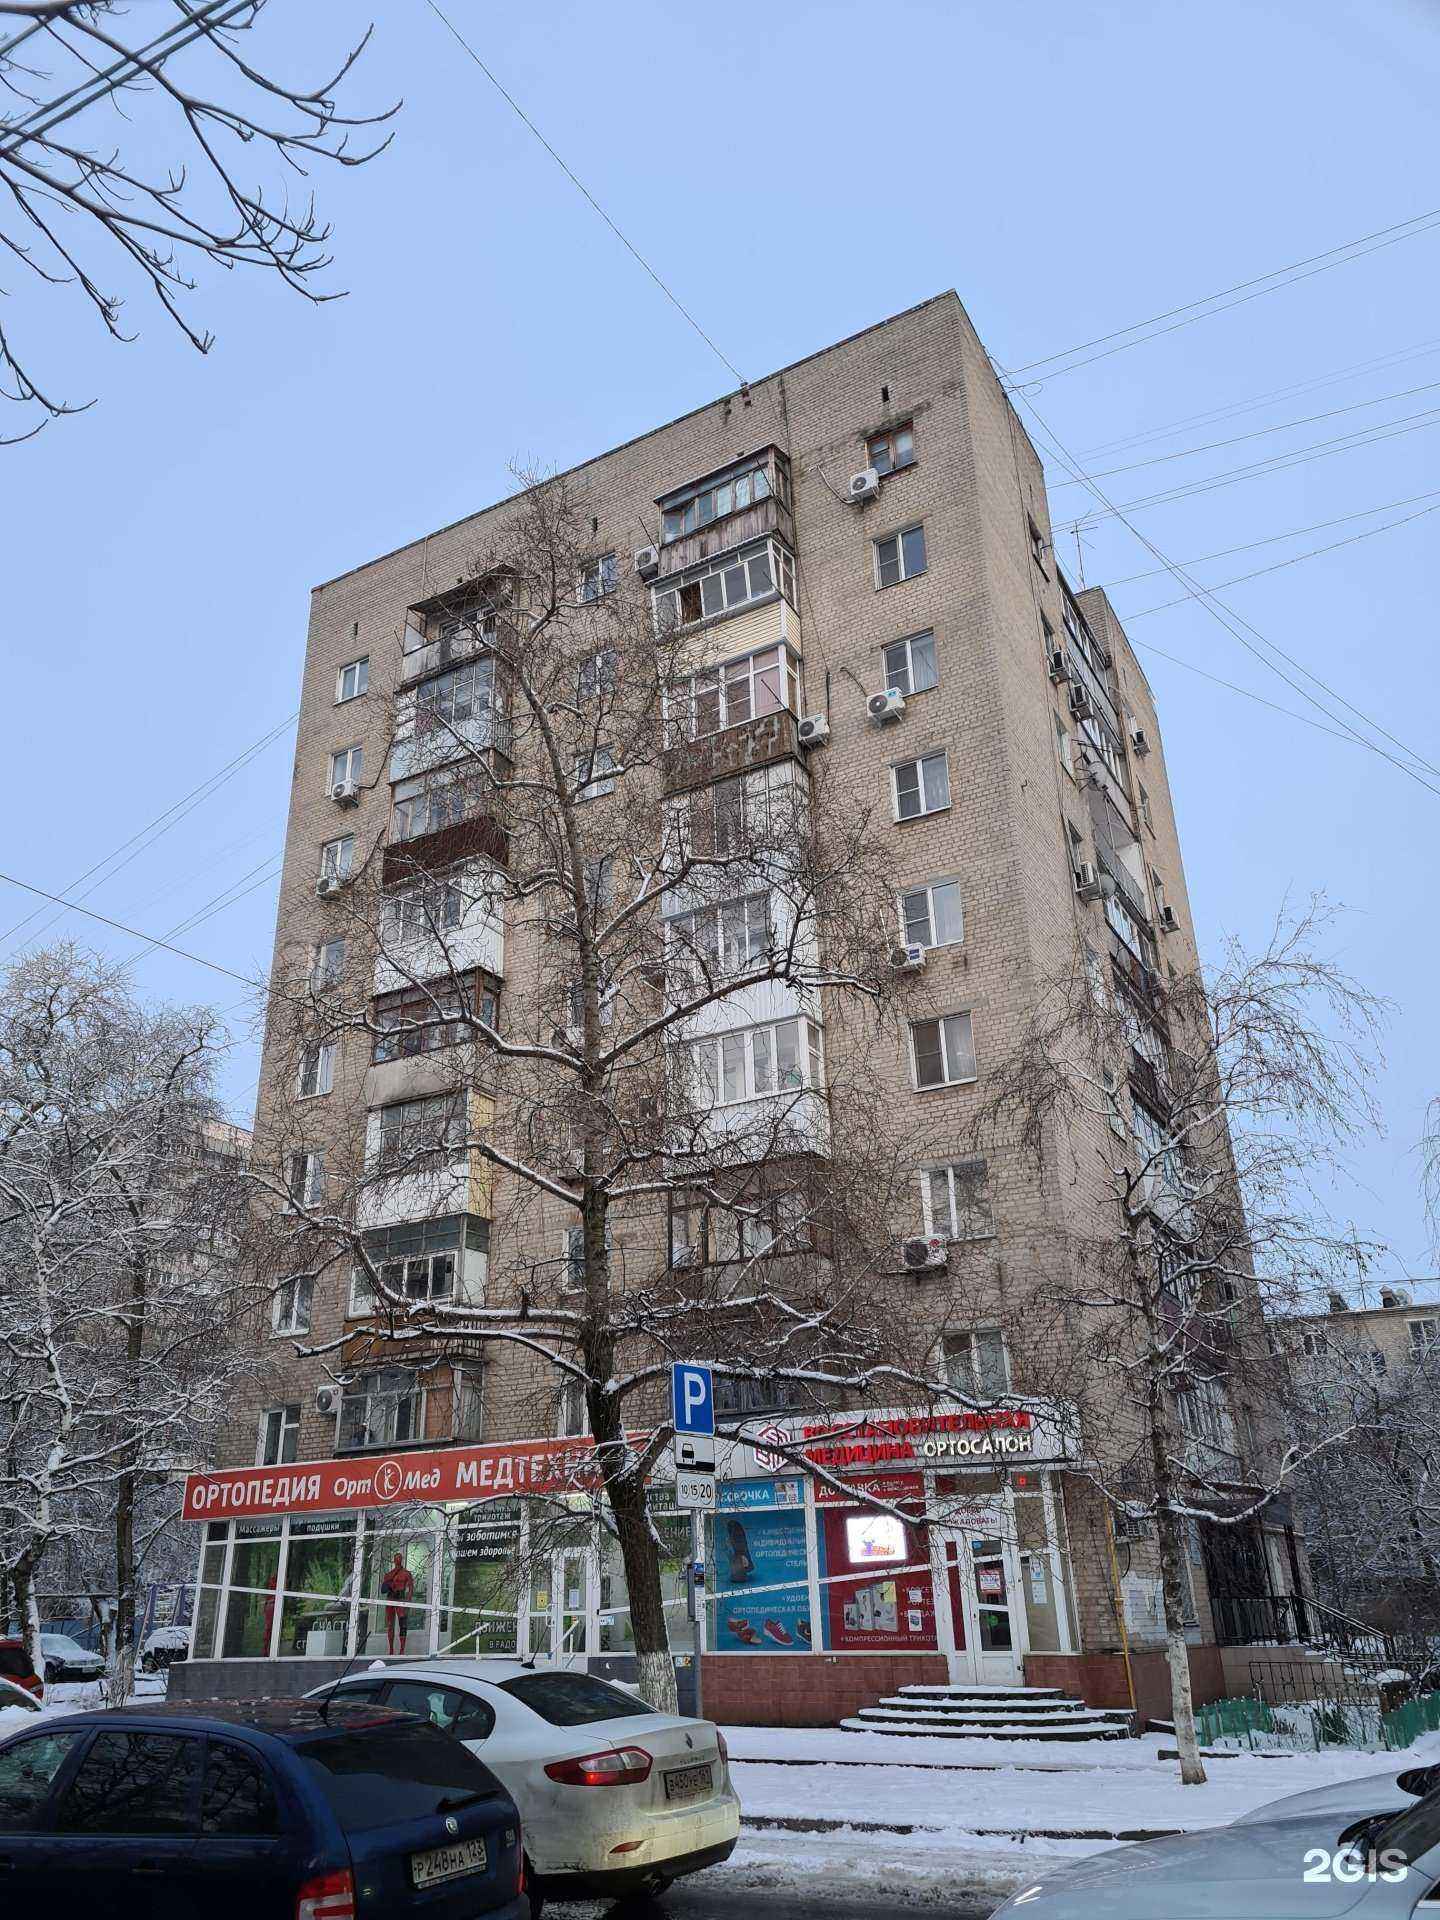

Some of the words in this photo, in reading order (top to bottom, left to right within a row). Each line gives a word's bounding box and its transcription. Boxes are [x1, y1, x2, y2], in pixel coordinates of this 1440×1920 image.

[684, 1372, 706, 1425] P
[806, 1442, 914, 1465] МЕДИЦИНА
[924, 1436, 1033, 1457] ОРТОСАЛОН
[191, 1474, 321, 1511] ОРТОПЕДИЯ
[690, 1485, 698, 1496] 15
[700, 1484, 711, 1498] 20
[818, 1479, 880, 1498] ДОАВКА
[306, 1522, 340, 1533] подушки
